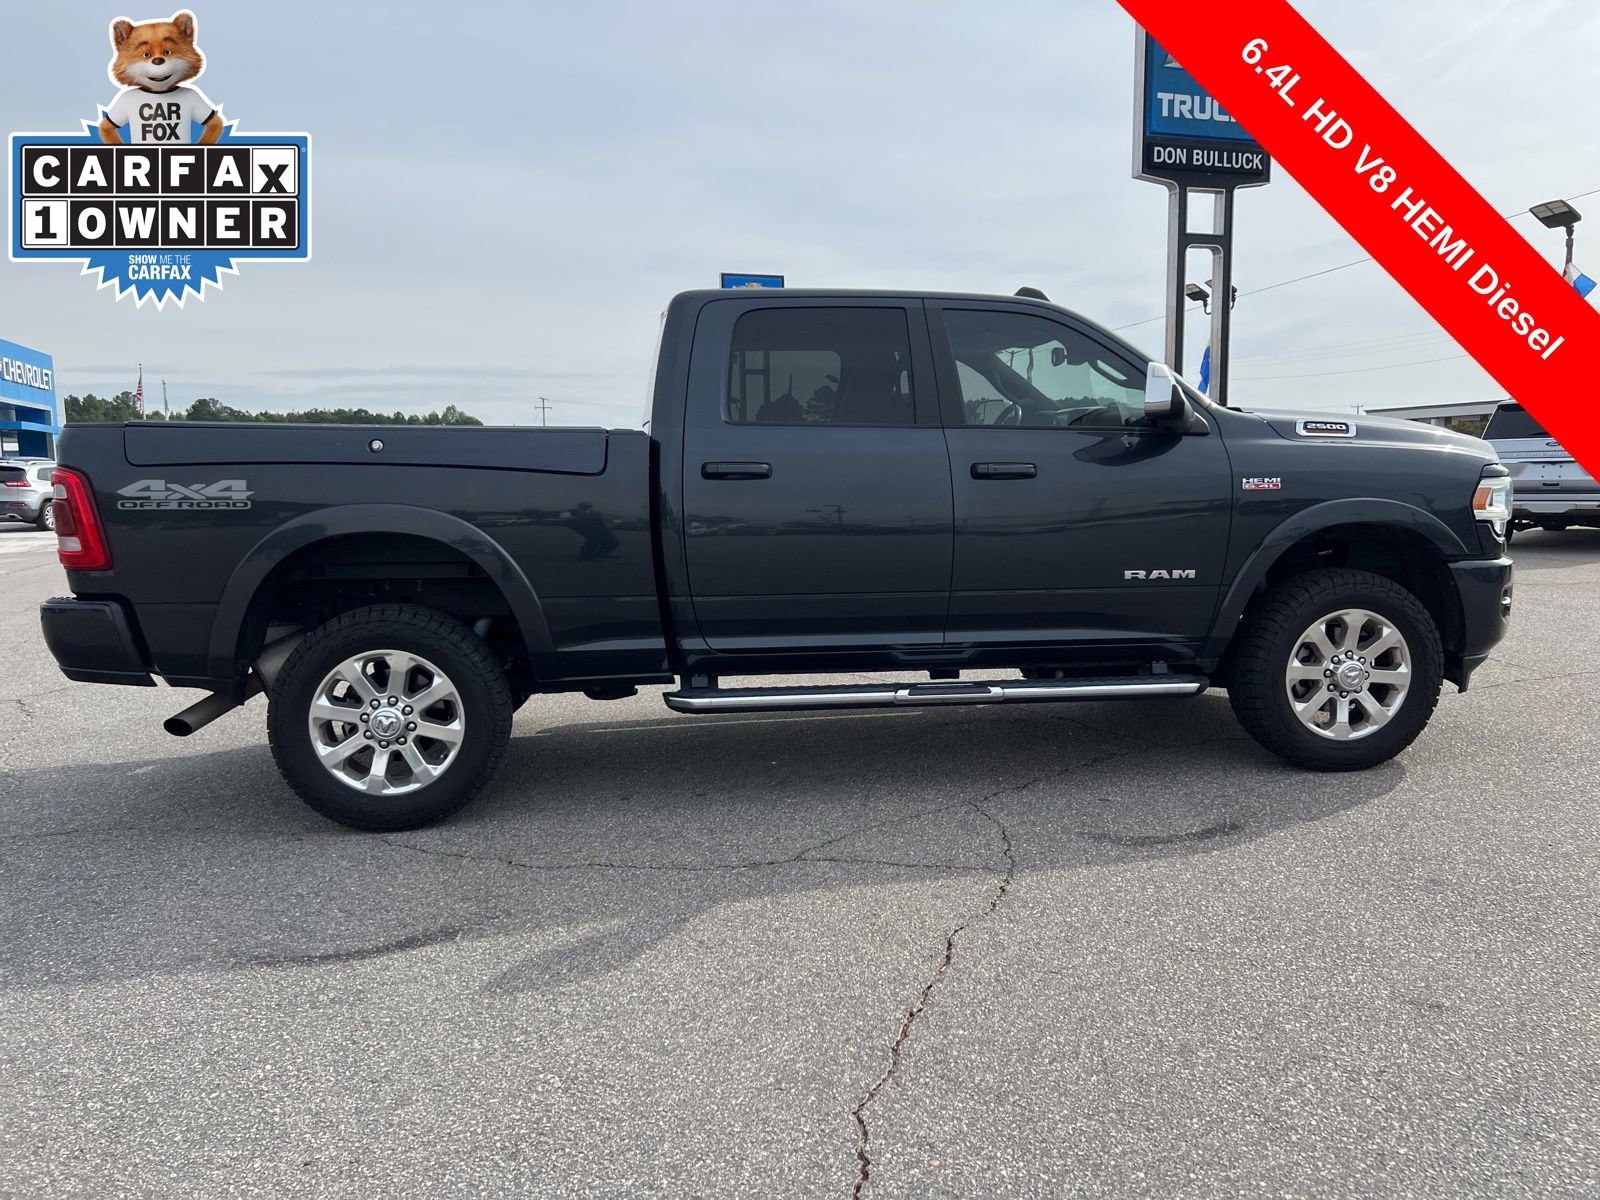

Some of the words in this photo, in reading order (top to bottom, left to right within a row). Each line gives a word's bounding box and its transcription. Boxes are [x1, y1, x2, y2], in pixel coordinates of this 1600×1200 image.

[1157, 92, 1237, 122] TRUC
[1153, 146, 1187, 164] DON
[1192, 149, 1263, 170] BULLUCK
[2, 357, 52, 390] CHEVROLET
[1306, 422, 1347, 430] 2500
[119, 501, 171, 509] OFF
[177, 501, 250, 509] ROAD
[1124, 569, 1196, 580] RAM
